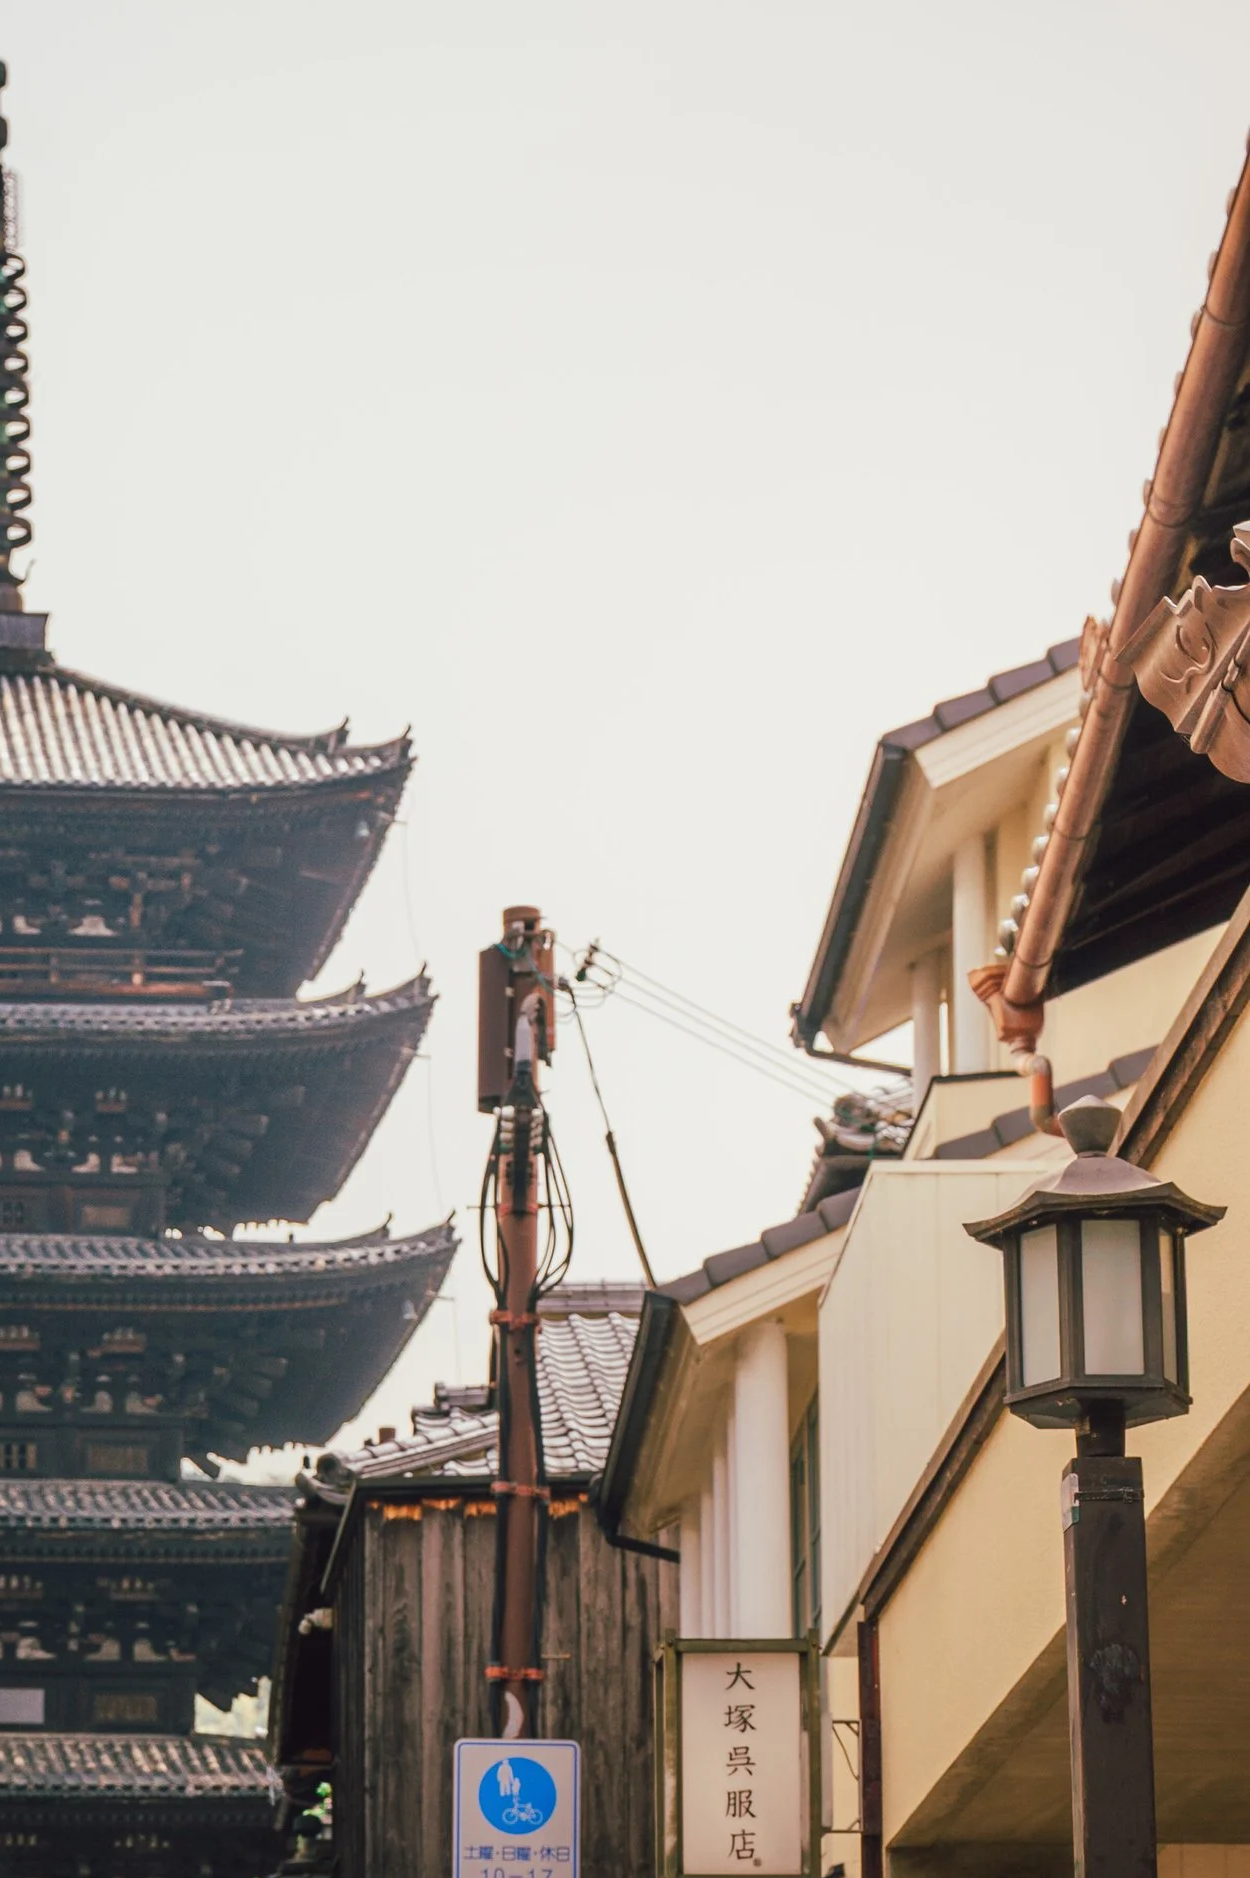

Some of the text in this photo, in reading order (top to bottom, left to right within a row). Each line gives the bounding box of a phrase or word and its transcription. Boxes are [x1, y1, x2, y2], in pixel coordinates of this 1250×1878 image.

[724, 1662, 757, 1861] 大塚呉服店
